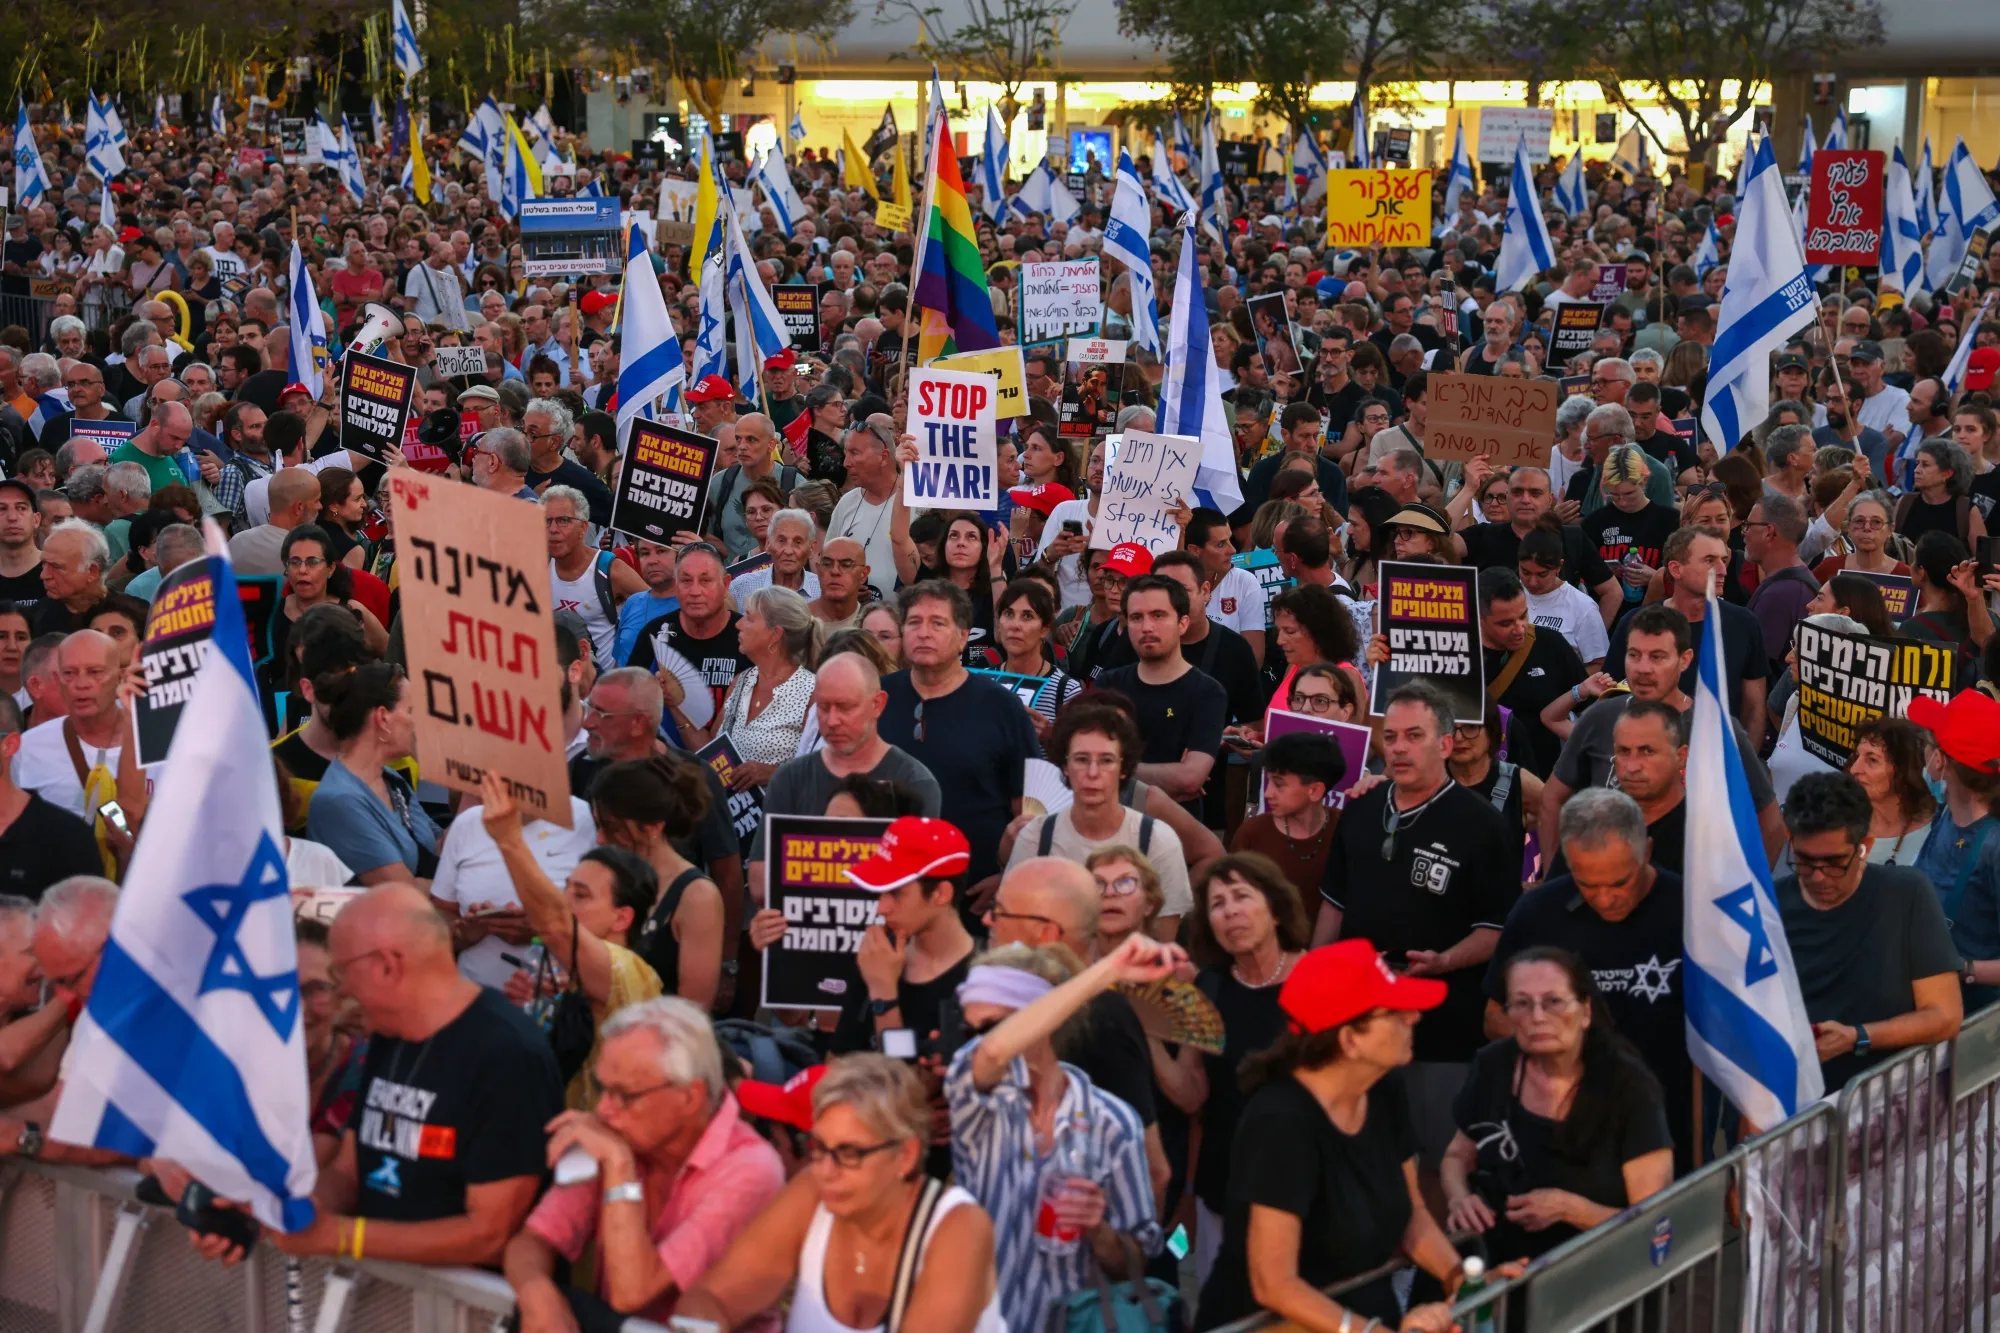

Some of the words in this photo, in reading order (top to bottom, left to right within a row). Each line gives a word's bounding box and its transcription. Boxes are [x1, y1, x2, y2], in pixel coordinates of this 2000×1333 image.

[1349, 170, 1430, 200] לעצור
[1828, 158, 1868, 190] זעקי
[523, 206, 550, 215] בשלטון
[1366, 197, 1403, 218] את
[1828, 191, 1863, 225] ארץ
[1330, 215, 1421, 244] המלחמה
[1807, 226, 1878, 254] אהובה!
[527, 264, 547, 272] בארון
[577, 261, 604, 270] והחטופים
[1060, 262, 1096, 277] מלחמת
[353, 364, 368, 376] את
[369, 370, 405, 387] מצילים
[351, 375, 403, 400] החטופים
[1435, 382, 1493, 405] מוציא
[347, 394, 400, 423] מסרבים
[918, 381, 987, 420] STOP
[1062, 402, 1079, 412] BRING
[347, 411, 396, 438] למלחמה
[1060, 413, 1072, 422] HIM
[1076, 423, 1092, 433] NOW!
[1461, 406, 1526, 427] למדינה
[640, 434, 660, 449] את
[661, 440, 704, 462] מצילים
[924, 422, 979, 459] THE
[1123, 440, 1153, 463] חיים
[1434, 432, 1500, 456] הנשמה
[1512, 437, 1542, 460] את
[637, 447, 701, 476] החטופים
[631, 468, 698, 502] מסרבים
[912, 463, 991, 500] WAR!
[628, 487, 694, 519] למלחמה
[1105, 503, 1145, 535] Stop
[1149, 509, 1176, 539] the
[1602, 527, 1620, 538] BRING
[1617, 536, 1633, 544] HOME
[410, 536, 541, 615] מדינה
[1392, 581, 1411, 597] את
[1414, 582, 1463, 600] מצילים
[1880, 586, 1907, 600] מציל
[1391, 599, 1464, 620] החטופים
[1533, 616, 1563, 628] מחזירים
[441, 610, 539, 679] תחת
[1390, 628, 1469, 652] מסרבים
[702, 658, 737, 672] מחזירים
[1390, 652, 1470, 675] למלחמה
[1800, 626, 1890, 681] הימים
[1800, 659, 1886, 707] מתרבים
[786, 839, 815, 858] את
[1413, 847, 1440, 859] STREET
[1440, 856, 1460, 868] TOUR
[786, 861, 853, 883] טופים
[1411, 856, 1451, 895] 89
[783, 896, 881, 926] מסרבים
